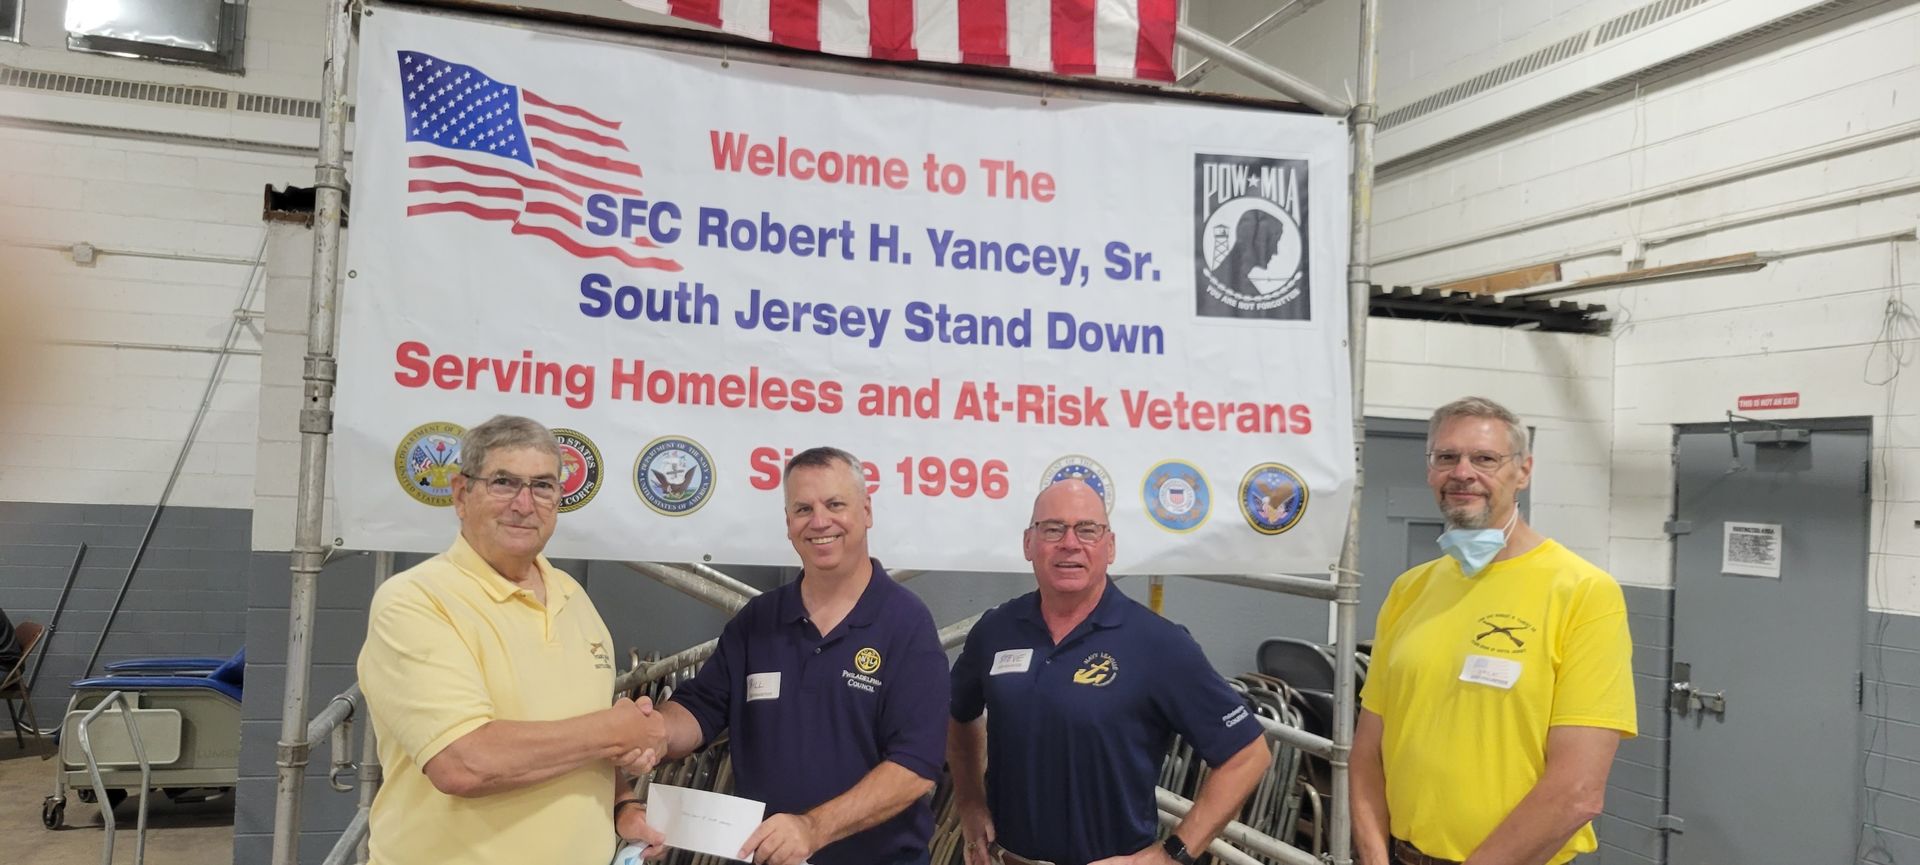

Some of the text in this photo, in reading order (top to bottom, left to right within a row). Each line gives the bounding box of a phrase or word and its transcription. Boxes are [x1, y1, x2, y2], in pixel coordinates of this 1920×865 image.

[709, 130, 1056, 203] Welcome to The
[1203, 163, 1301, 227] POW MIA
[586, 193, 1161, 287] SFC Robert H. Yancey, Sr.
[579, 273, 1165, 356] South Jersey Stand Down
[1206, 285, 1222, 300] YOU
[1221, 295, 1238, 308] ARE
[1238, 301, 1255, 310] NOT
[394, 341, 1313, 437] Serving Homeless and At-Risk Veterans
[1739, 400, 1753, 408] THIS
[1760, 398, 1773, 407] NOT
[1783, 396, 1797, 405] EXIT
[567, 437, 596, 469] STATES
[749, 446, 880, 495] Sie
[895, 456, 1009, 500] 1996
[565, 480, 595, 505] CORPS
[1083, 652, 1099, 665] NAVY
